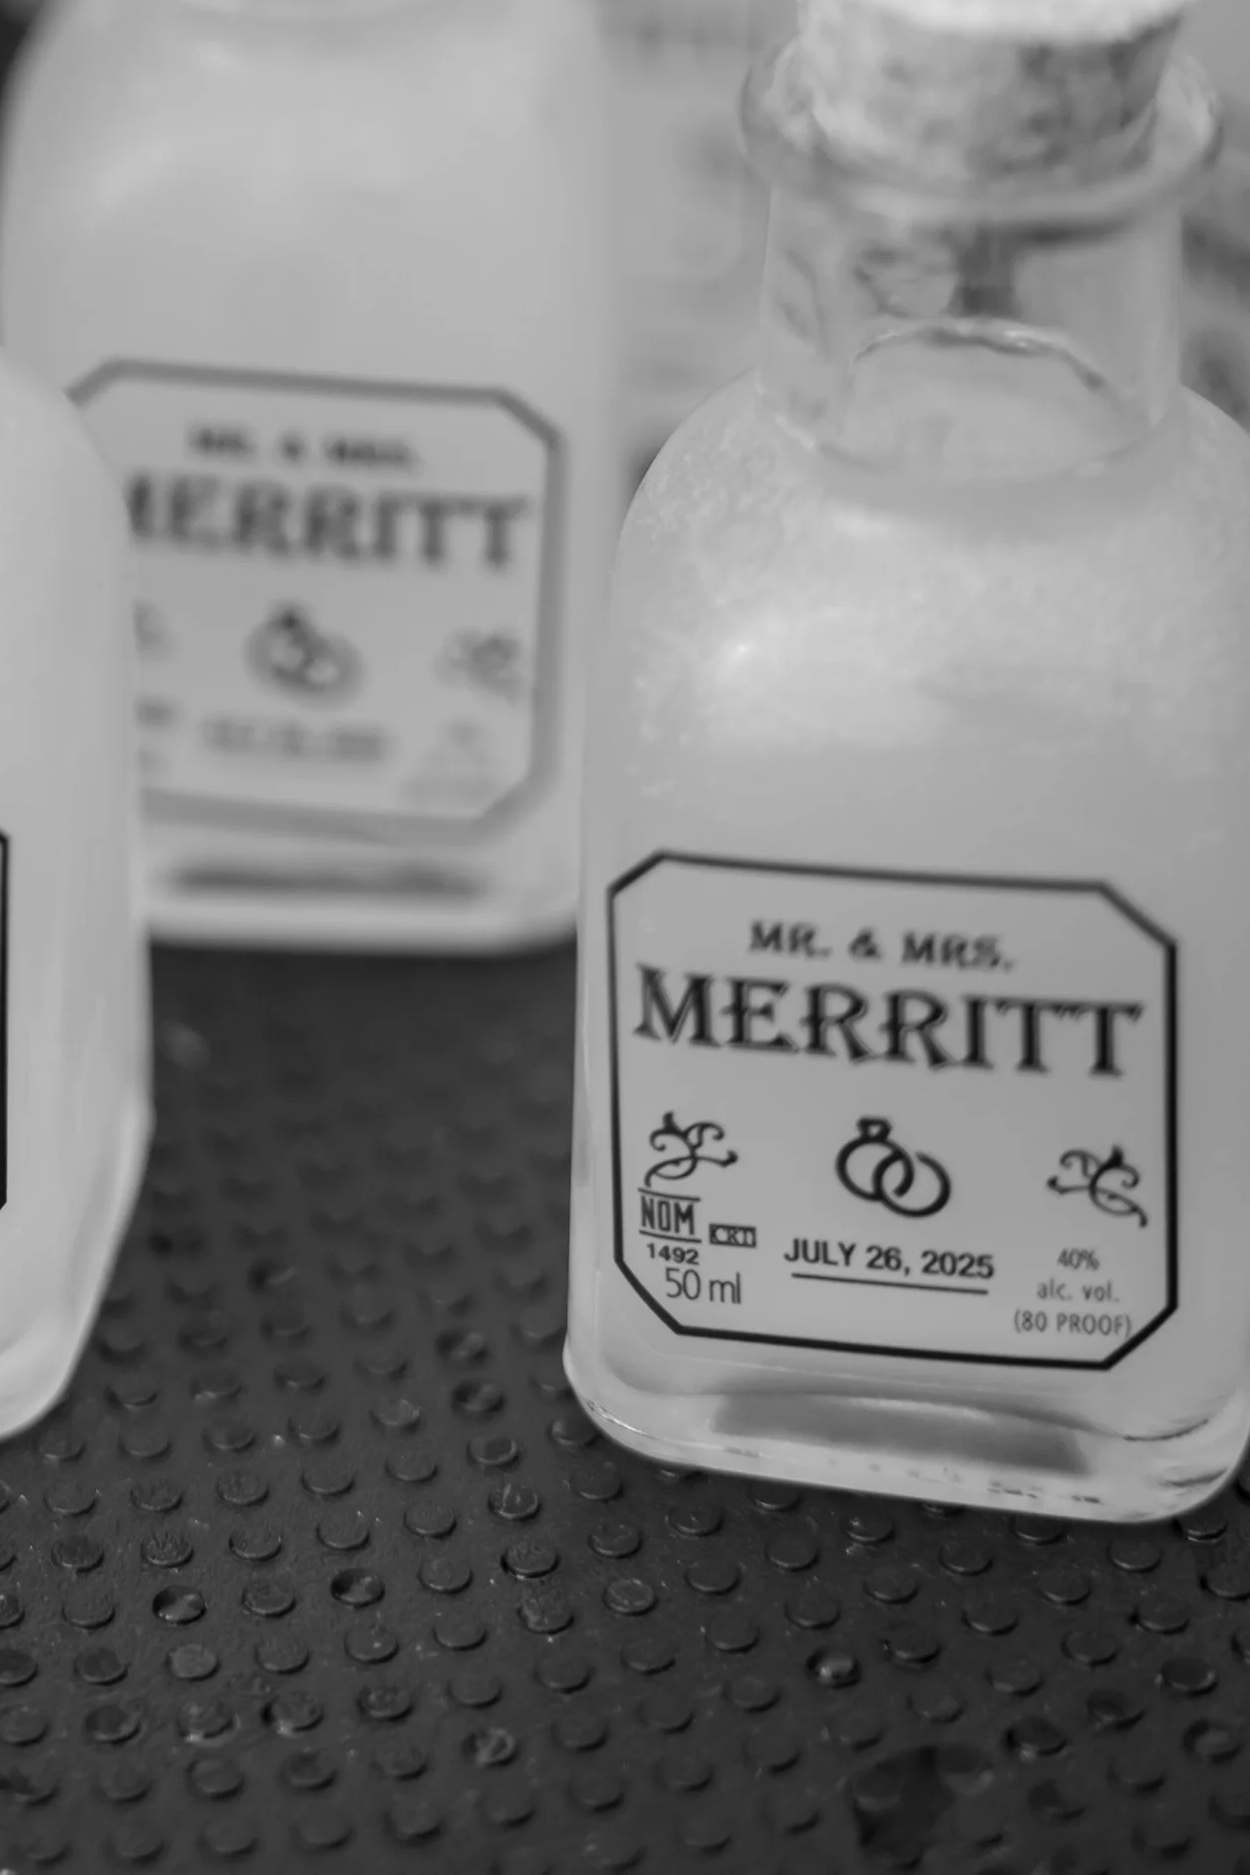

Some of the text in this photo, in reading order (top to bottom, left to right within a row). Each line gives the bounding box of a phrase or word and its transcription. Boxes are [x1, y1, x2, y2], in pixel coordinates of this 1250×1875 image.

[748, 919, 1014, 972] MR. & MRS.
[632, 963, 1146, 1079] MERRITT
[640, 1194, 696, 1235] NOM
[647, 1242, 700, 1265] 1492
[783, 1237, 995, 1280] JULY 26, 2025
[1056, 1247, 1101, 1272] 40%
[665, 1266, 742, 1305] 50 ml
[1036, 1276, 1121, 1303] alc. vol.
[1013, 1307, 1134, 1340] (80 PROOF)
